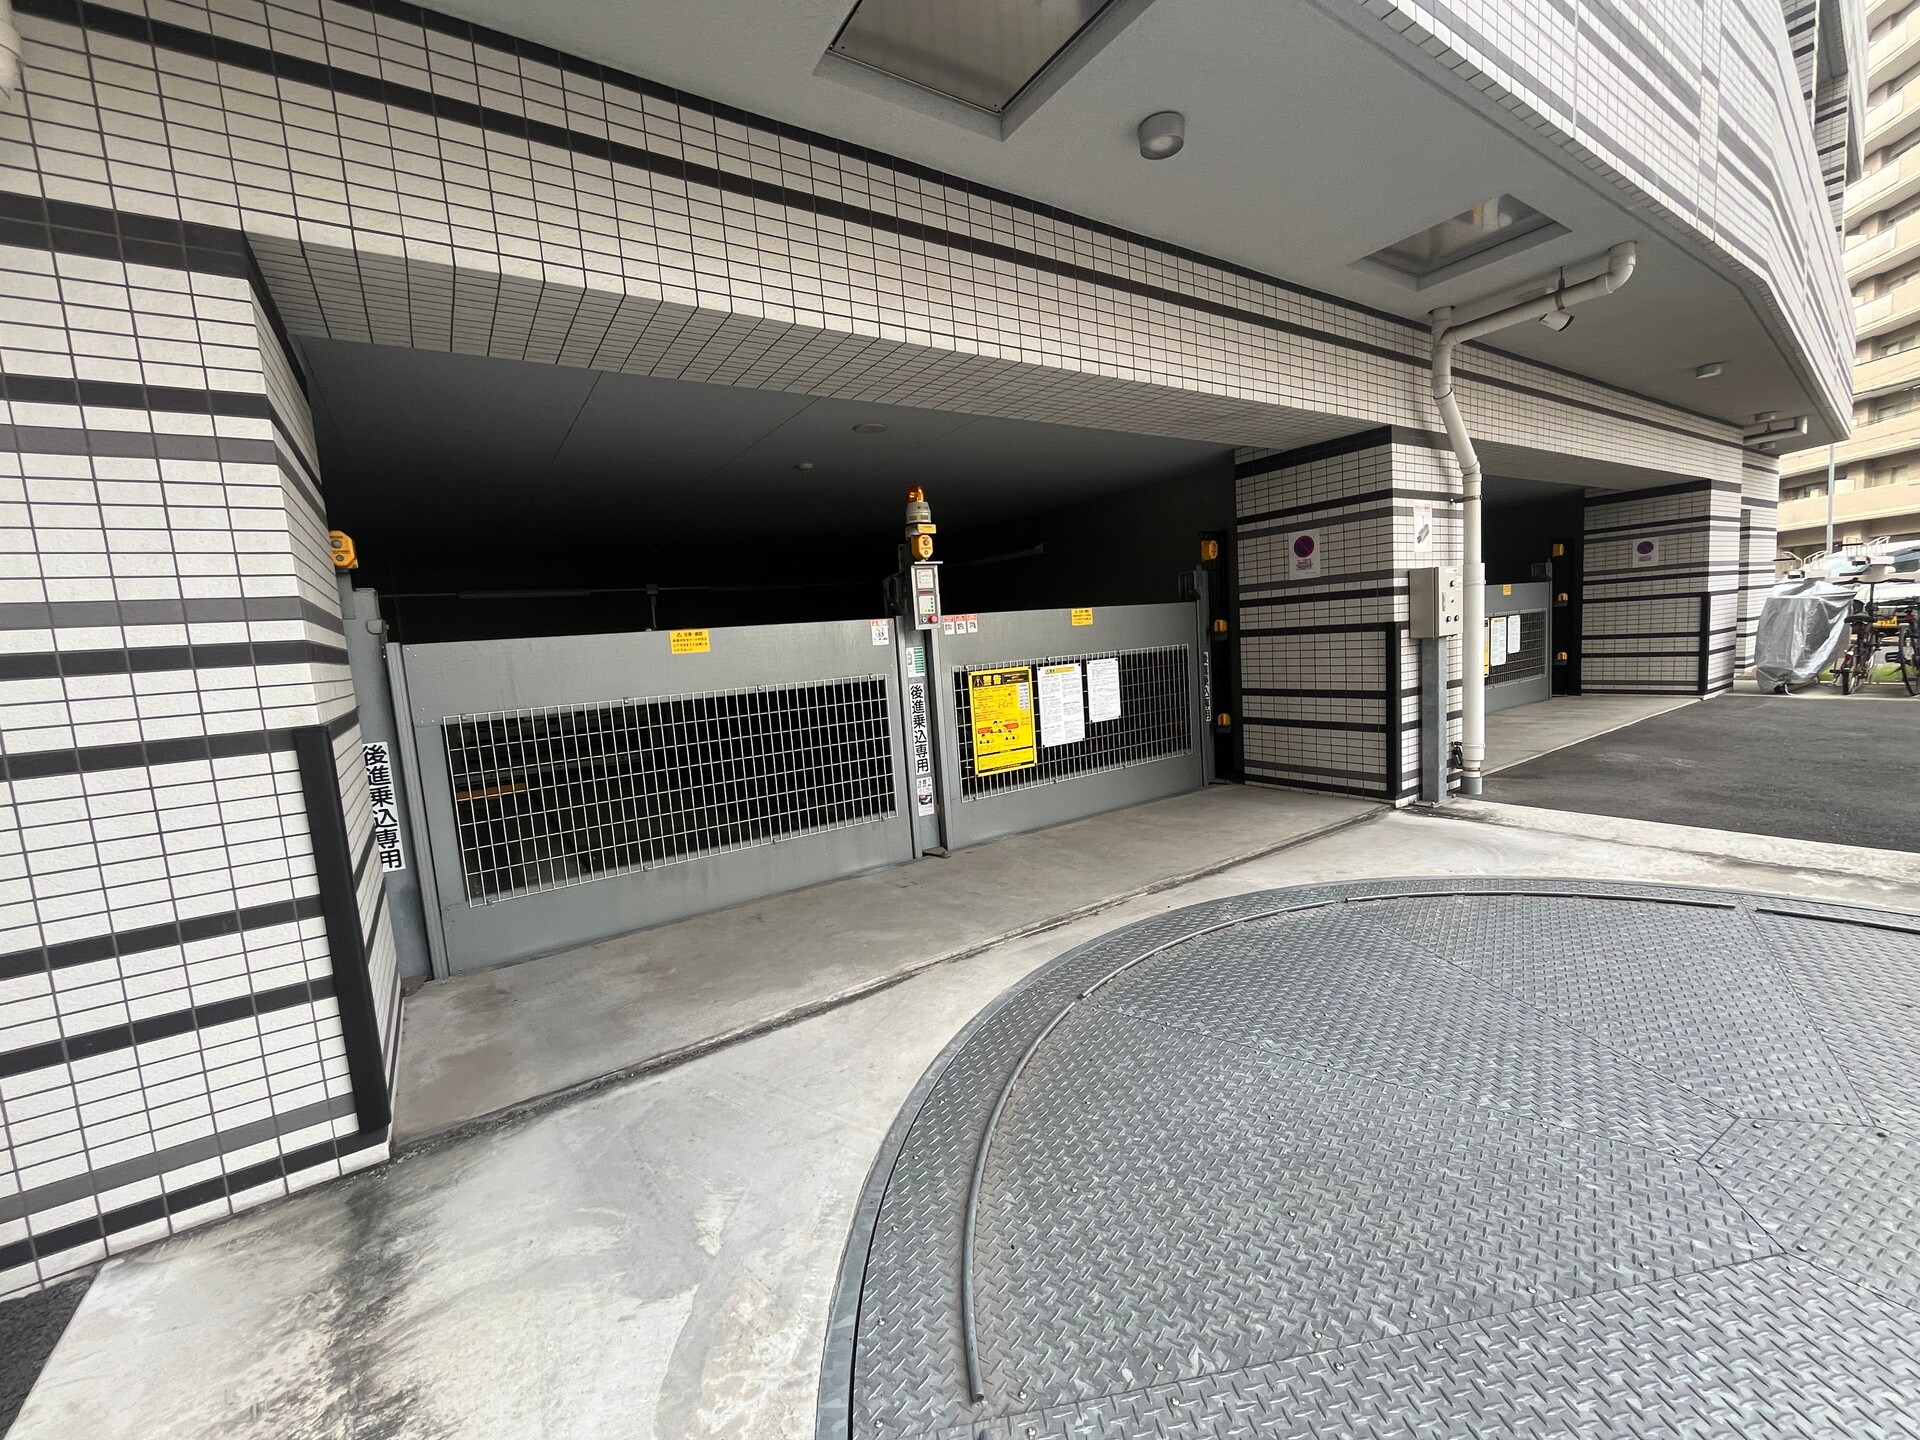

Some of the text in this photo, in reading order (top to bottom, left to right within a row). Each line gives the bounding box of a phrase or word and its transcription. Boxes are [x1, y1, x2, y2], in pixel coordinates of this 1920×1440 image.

[910, 684, 929, 773] 後進乗込専用
[362, 744, 402, 869] 後進乗込専用
